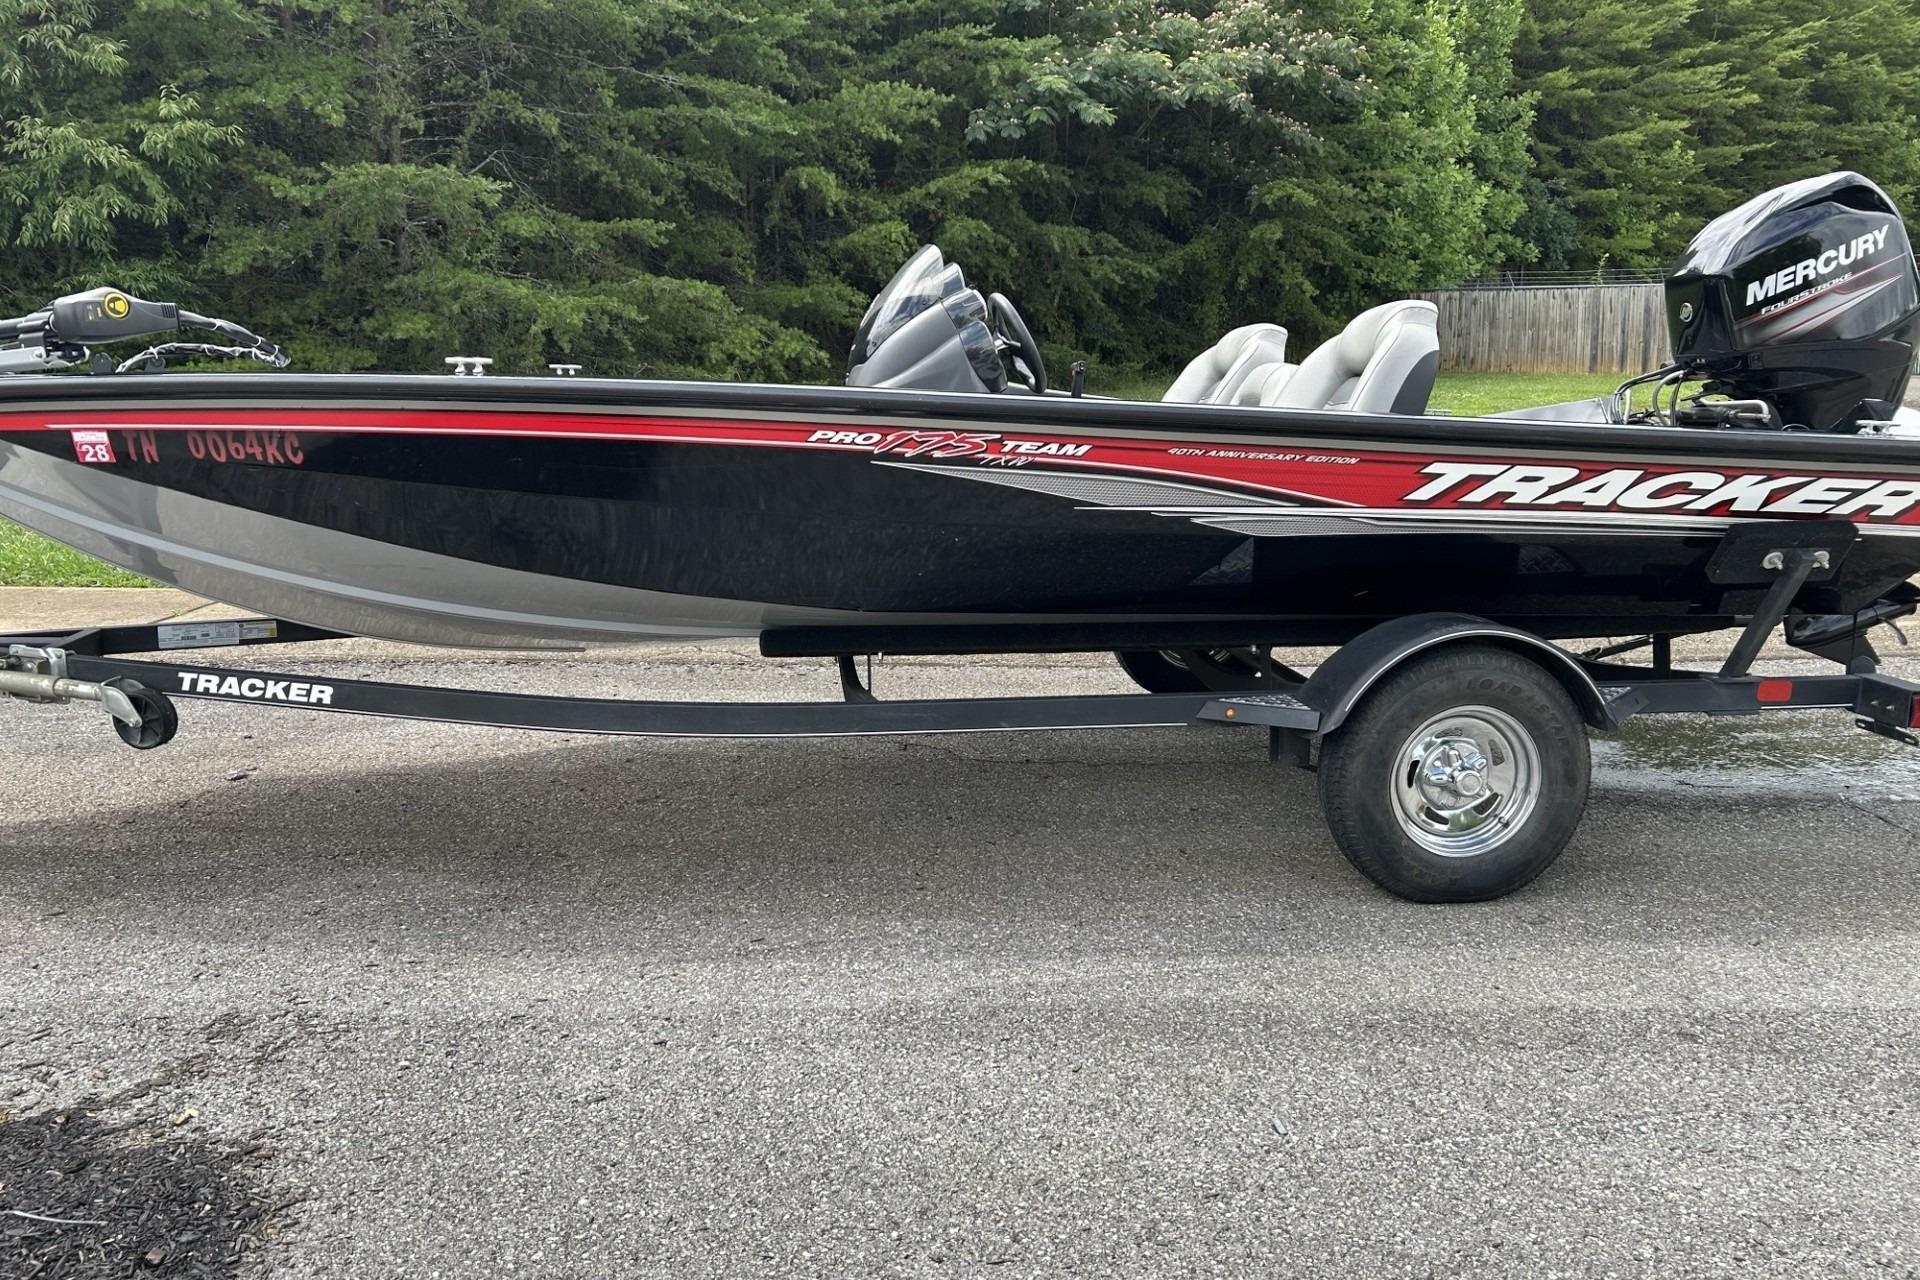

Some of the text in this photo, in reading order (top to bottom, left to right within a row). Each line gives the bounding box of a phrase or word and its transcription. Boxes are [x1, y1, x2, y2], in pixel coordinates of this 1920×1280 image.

[1746, 224, 1889, 306] MERCURY
[1760, 271, 1854, 315] FOURSTROKE
[81, 444, 110, 462] 28
[122, 431, 304, 464] TN 0064KC
[807, 430, 1092, 458] PRO 175 TEAM
[979, 454, 1034, 466] TXW
[1168, 447, 1361, 465] 40TH ANNIVERSARY EDITION
[1403, 462, 1920, 516] TRACKER
[177, 671, 334, 705] TRACKER
